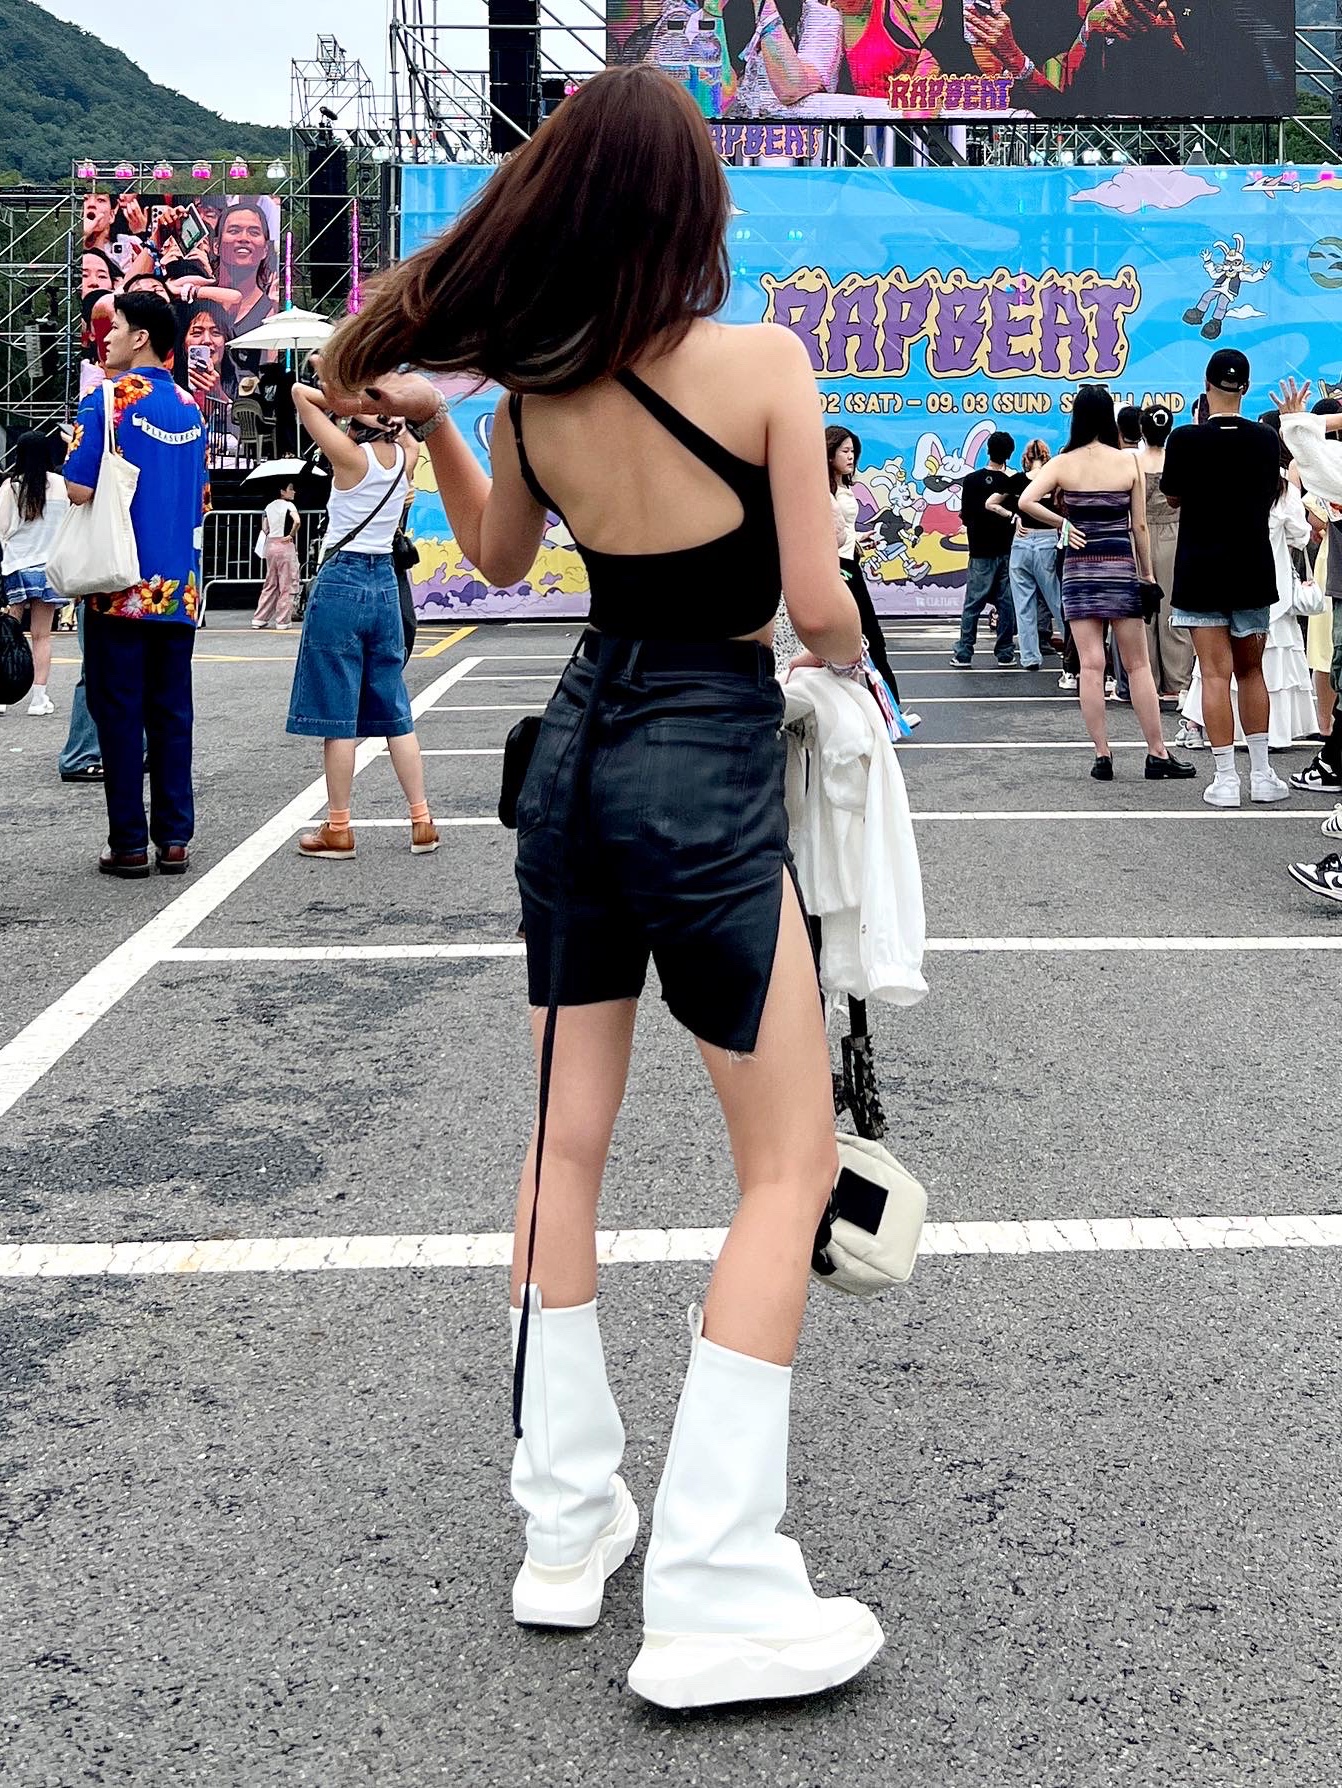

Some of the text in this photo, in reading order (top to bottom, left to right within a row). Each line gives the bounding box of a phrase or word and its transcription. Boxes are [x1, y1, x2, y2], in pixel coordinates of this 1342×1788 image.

[889, 75, 1014, 110] RAPBEAT
[765, 270, 1140, 378] RAPBEAT
[844, 392, 903, 413] (SAT)
[926, 392, 958, 413] 09.
[962, 392, 989, 413] 03
[992, 392, 1052, 413] (SUN)
[145, 424, 195, 443] PLEASURES
